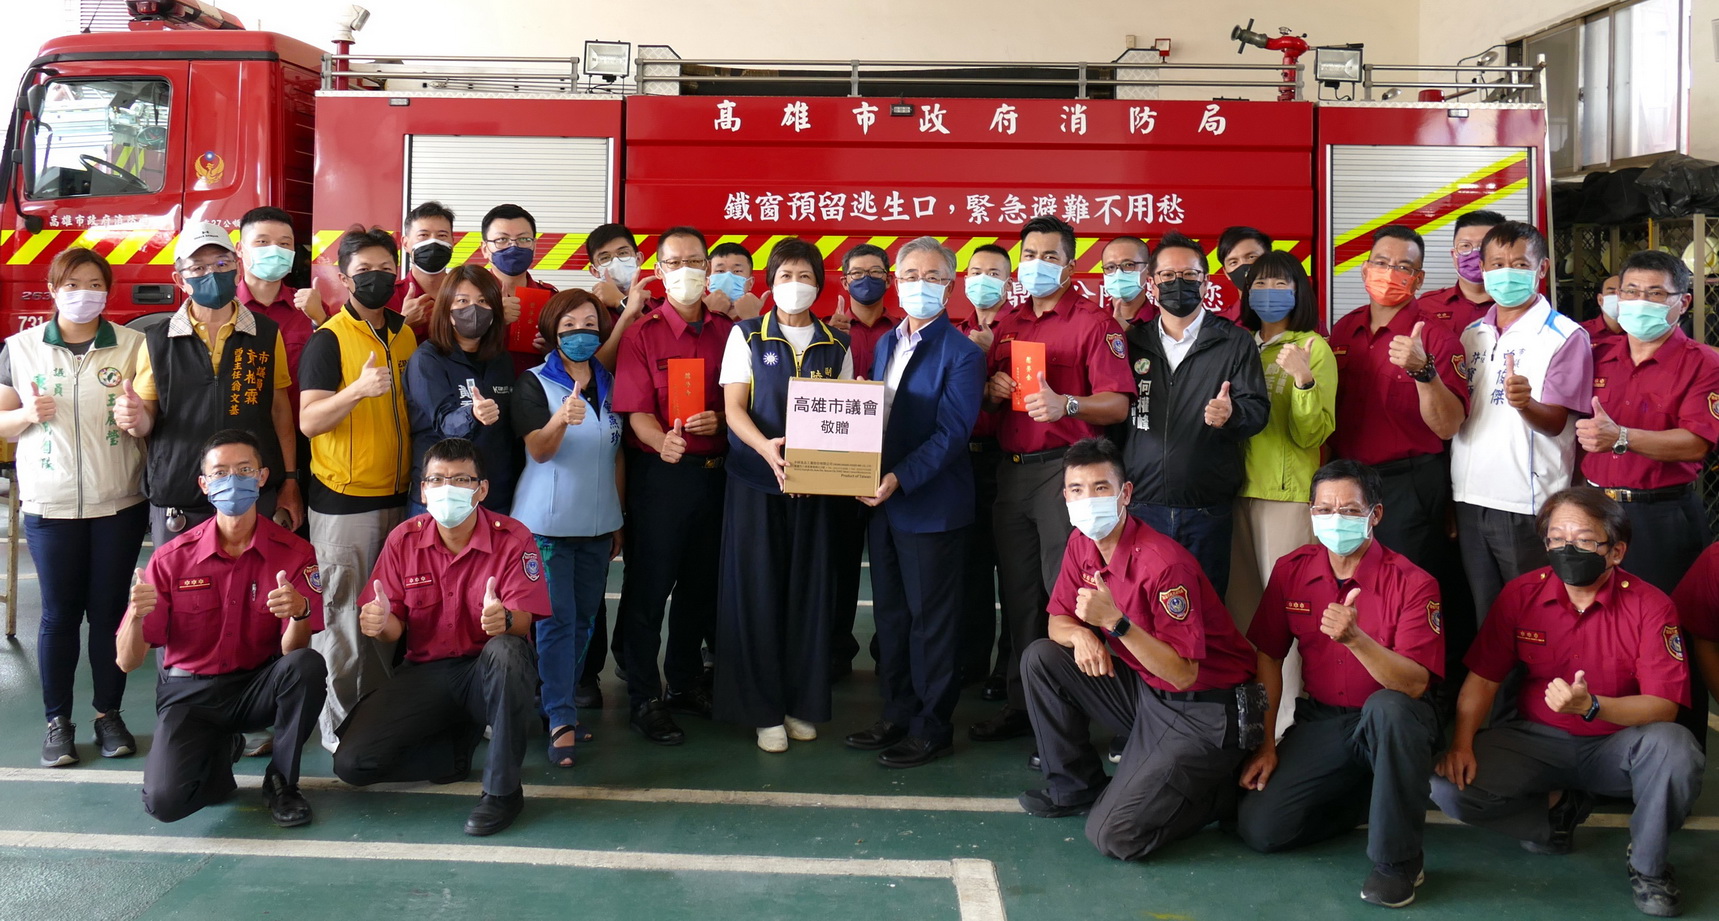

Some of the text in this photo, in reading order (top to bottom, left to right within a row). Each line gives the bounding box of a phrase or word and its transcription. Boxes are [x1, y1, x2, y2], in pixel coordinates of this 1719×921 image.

[714, 99, 1226, 136] 高雄市政府消防局
[794, 396, 878, 416] 高雄市議會
[821, 420, 849, 435] 敬贈
